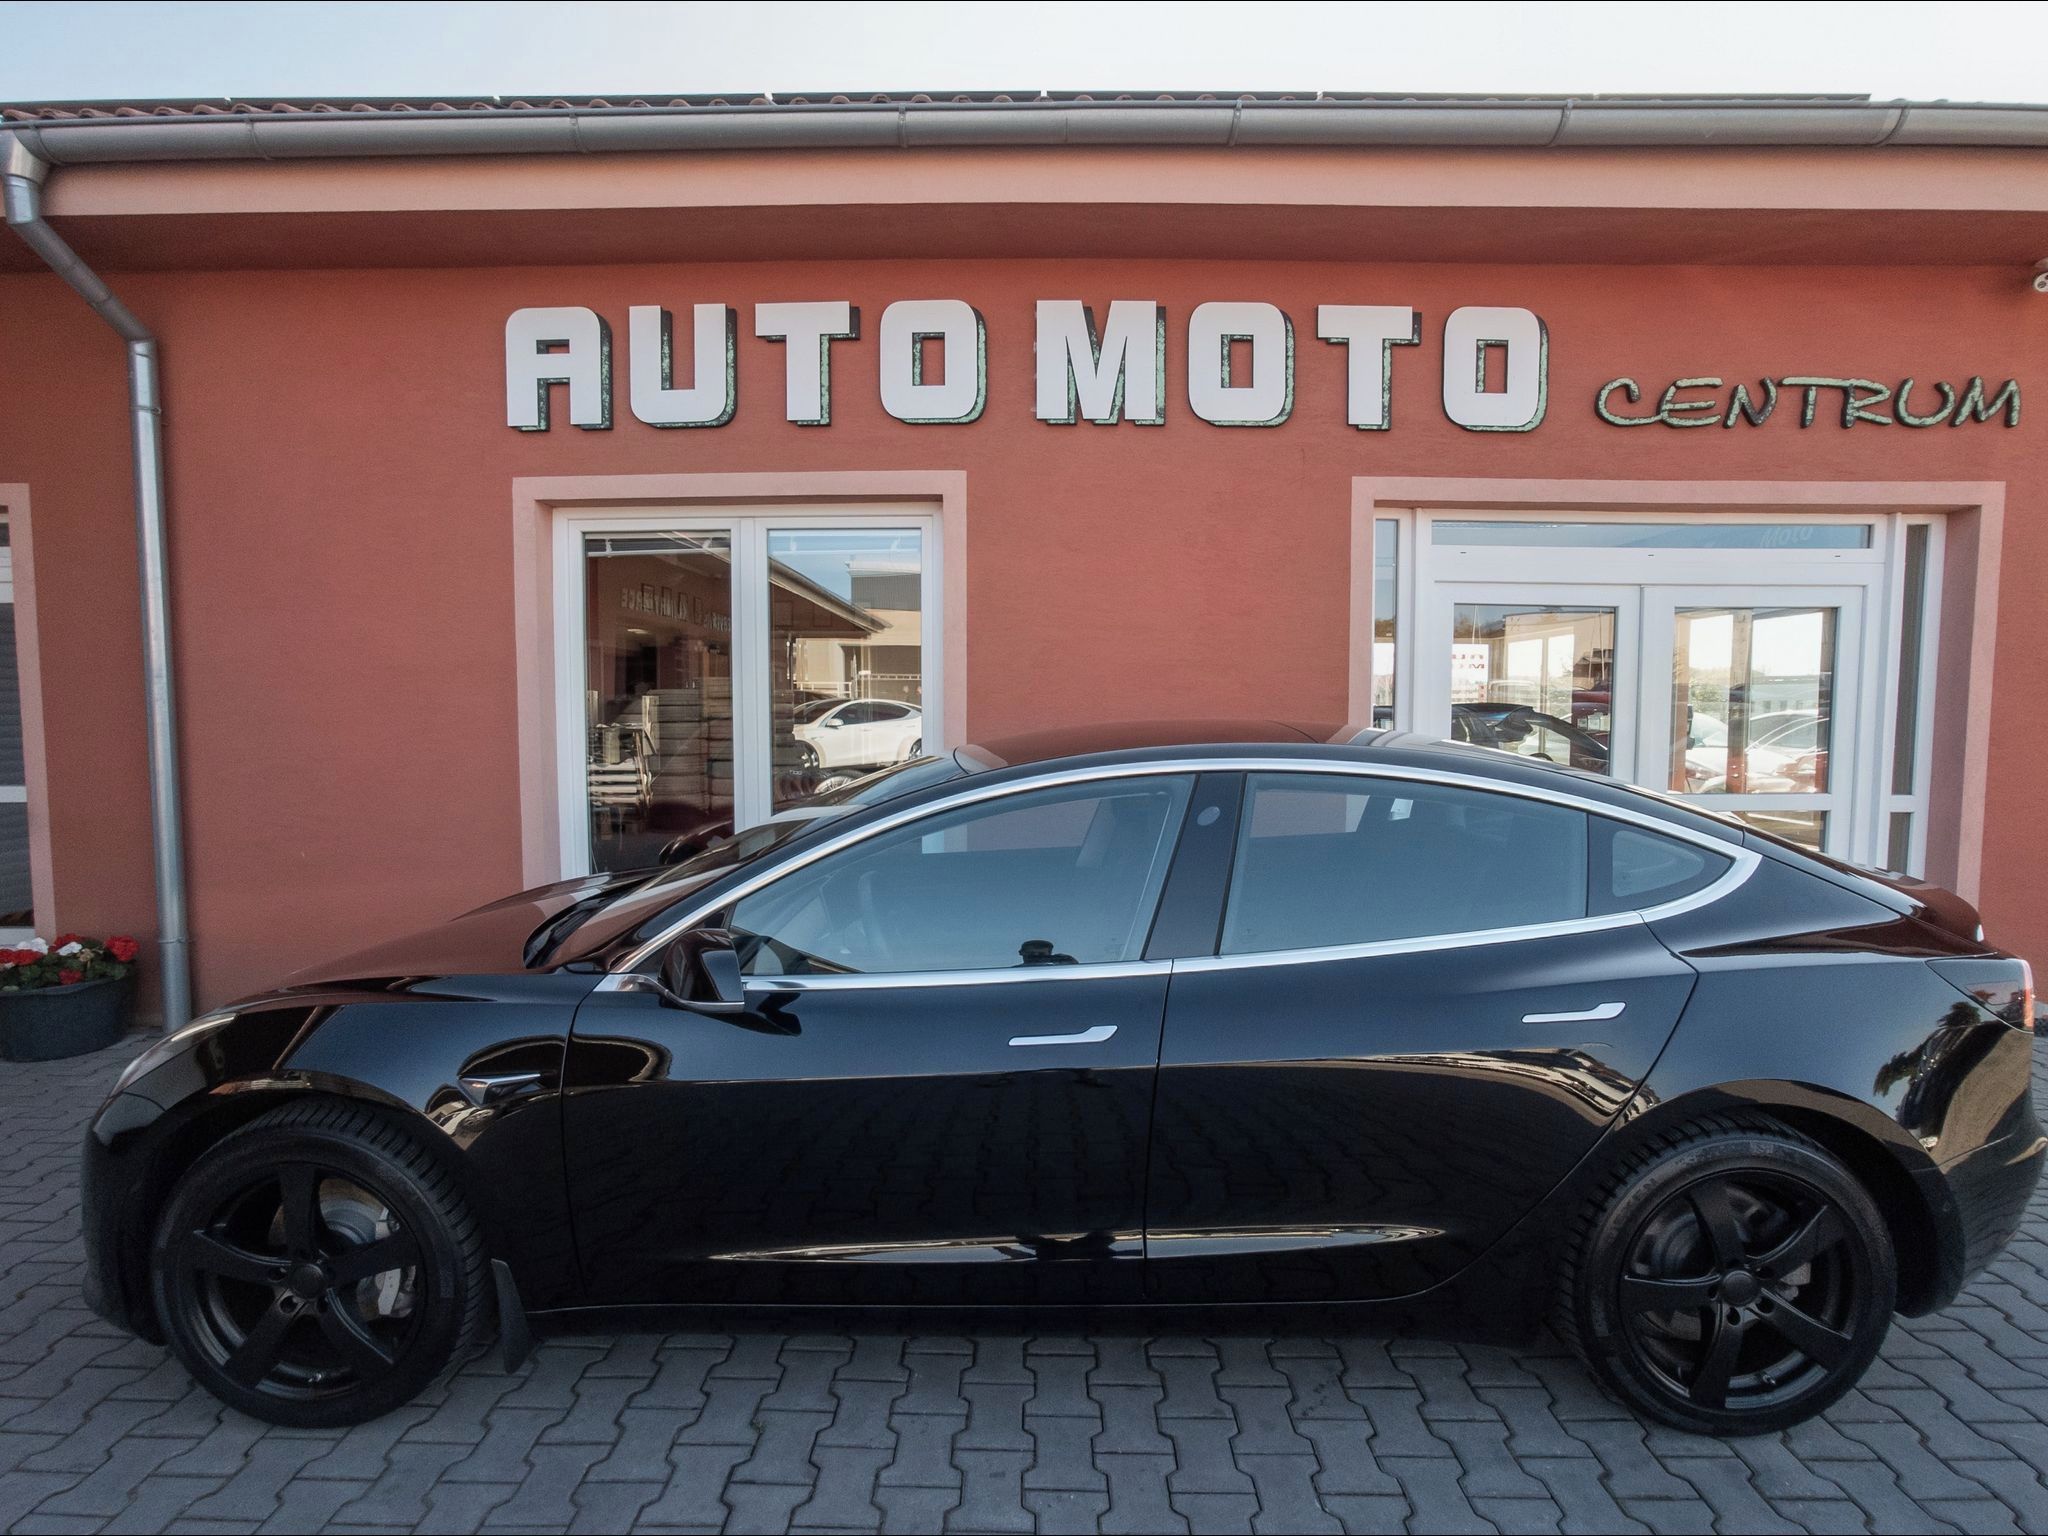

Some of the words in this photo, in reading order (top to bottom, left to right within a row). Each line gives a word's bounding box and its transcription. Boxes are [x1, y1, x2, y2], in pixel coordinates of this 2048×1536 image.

[506, 299, 987, 430] AUTO
[1036, 299, 1549, 432] MOTO
[1595, 376, 2021, 428] CENTRUM
